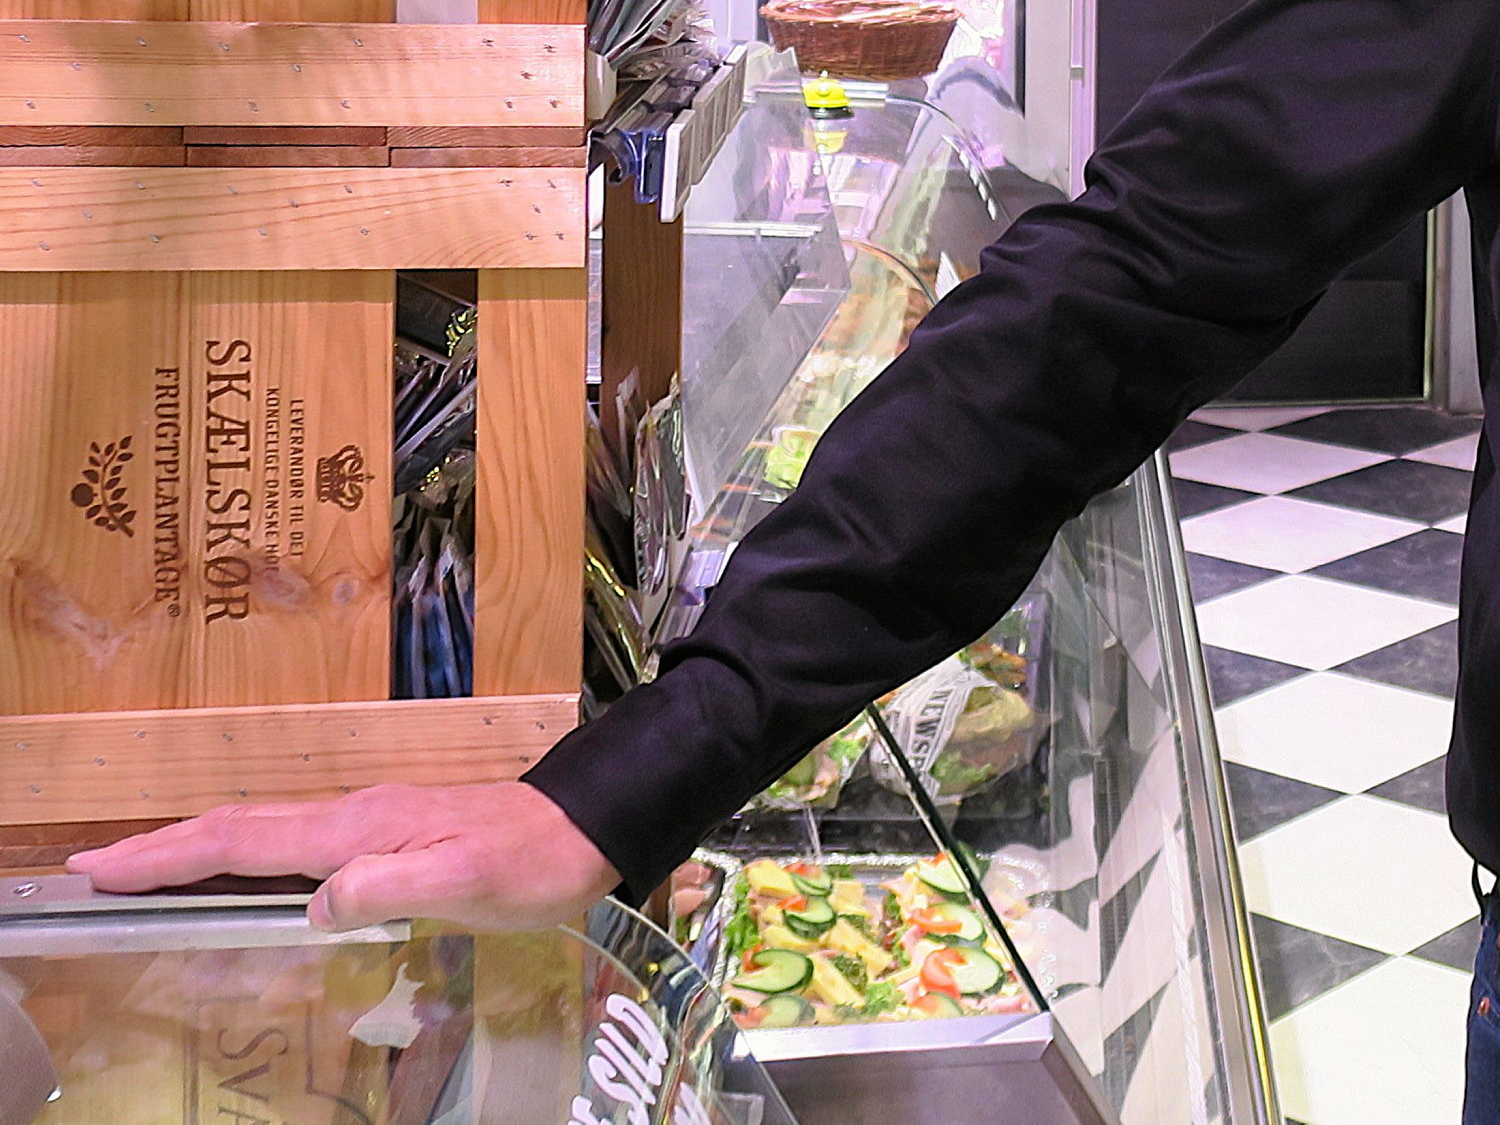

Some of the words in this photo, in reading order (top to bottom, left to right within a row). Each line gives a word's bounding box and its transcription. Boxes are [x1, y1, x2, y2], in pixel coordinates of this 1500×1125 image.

[265, 387, 280, 472] KONGELIGE
[289, 399, 304, 499] LEVERANDØR
[204, 339, 252, 625] SKÆLSKØR
[265, 480, 280, 538] DANSKE
[289, 505, 304, 524] TIL
